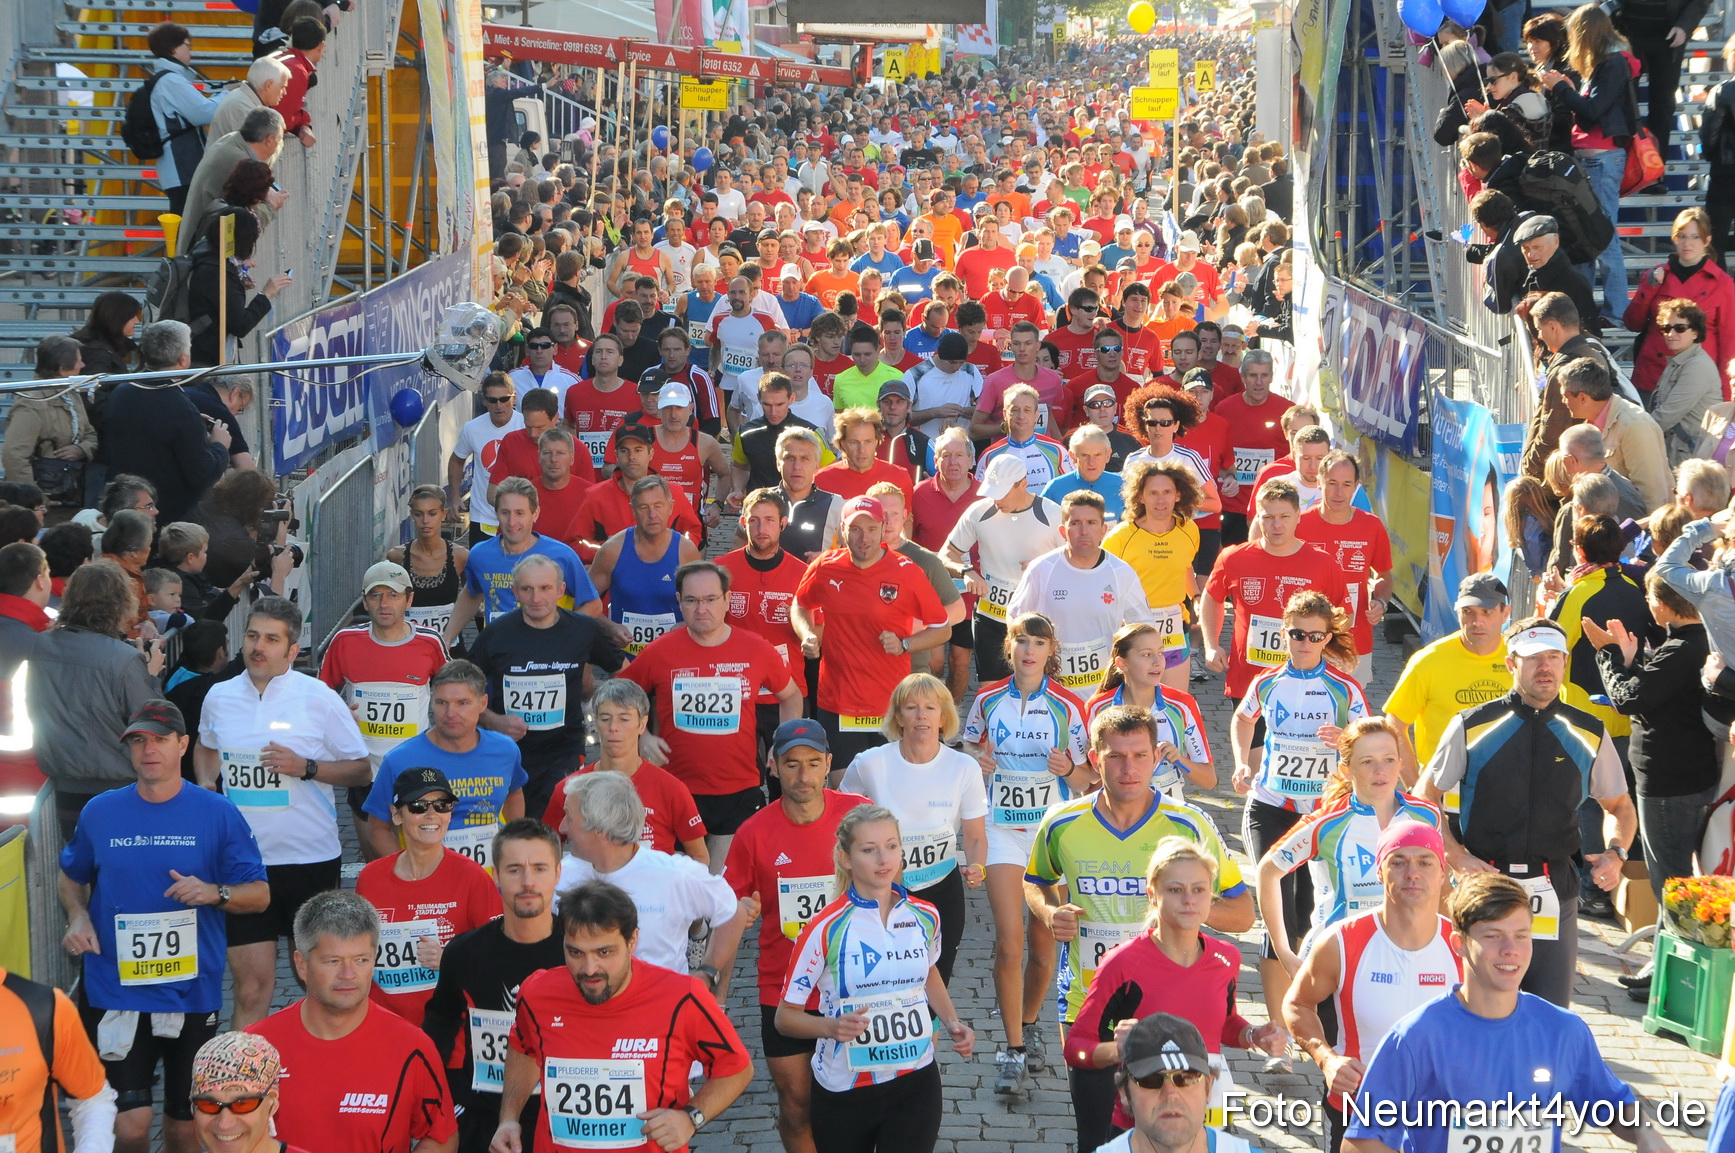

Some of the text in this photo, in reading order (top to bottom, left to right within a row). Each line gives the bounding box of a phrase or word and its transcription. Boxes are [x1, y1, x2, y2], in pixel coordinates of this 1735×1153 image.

[1056, 28, 1064, 38] B
[494, 34, 603, 55] Miet- & Serviceline: 09181 6352
[722, 59, 743, 73] 6352
[889, 59, 900, 74] A
[1150, 61, 1177, 70] Jugend-
[1157, 69, 1170, 77] lauf
[1200, 71, 1211, 86] A
[684, 85, 725, 95] Schnupper-
[697, 94, 711, 102] lauf
[1134, 96, 1175, 105] Schnupper-
[1148, 104, 1162, 112] lauf
[726, 352, 753, 368] 2693
[633, 626, 665, 643] 693
[1067, 653, 1100, 674] 156
[1068, 673, 1102, 686] Steffen
[363, 690, 390, 698] PFLEIDERER
[509, 690, 559, 711] 2477
[680, 693, 734, 714] 2823
[366, 701, 405, 722] 570
[523, 712, 548, 723] Graf
[1294, 712, 1329, 720] PLAST
[684, 715, 730, 727] Thomas
[367, 723, 405, 736] Walter
[1015, 731, 1049, 740] PLAST
[1277, 754, 1330, 779] 2274
[229, 764, 281, 789] 3504
[1281, 779, 1323, 793] Monika
[1000, 785, 1051, 808] 2617
[110, 838, 133, 848] ING
[1075, 860, 1131, 874] TEAM
[790, 882, 825, 890] PFLEIDERER
[415, 908, 449, 916] STADTLAUF
[417, 901, 457, 909] NEUMARKTER
[126, 919, 161, 927] PFLEIDERER
[1087, 928, 1121, 937] PFLEIDERER
[132, 930, 181, 959] 579
[375, 940, 419, 968] 284
[886, 948, 925, 961] PLAST
[132, 961, 181, 976] Jürgen
[378, 968, 436, 988] Angelika
[855, 976, 925, 990] www.tr-plast.de
[611, 1038, 659, 1052] JURA
[868, 1043, 918, 1062] Kristin
[558, 1066, 599, 1076] PFLEIDERER
[339, 1092, 388, 1108] JURA
[555, 1082, 634, 1116] 2364
[566, 1117, 627, 1137] Werner
